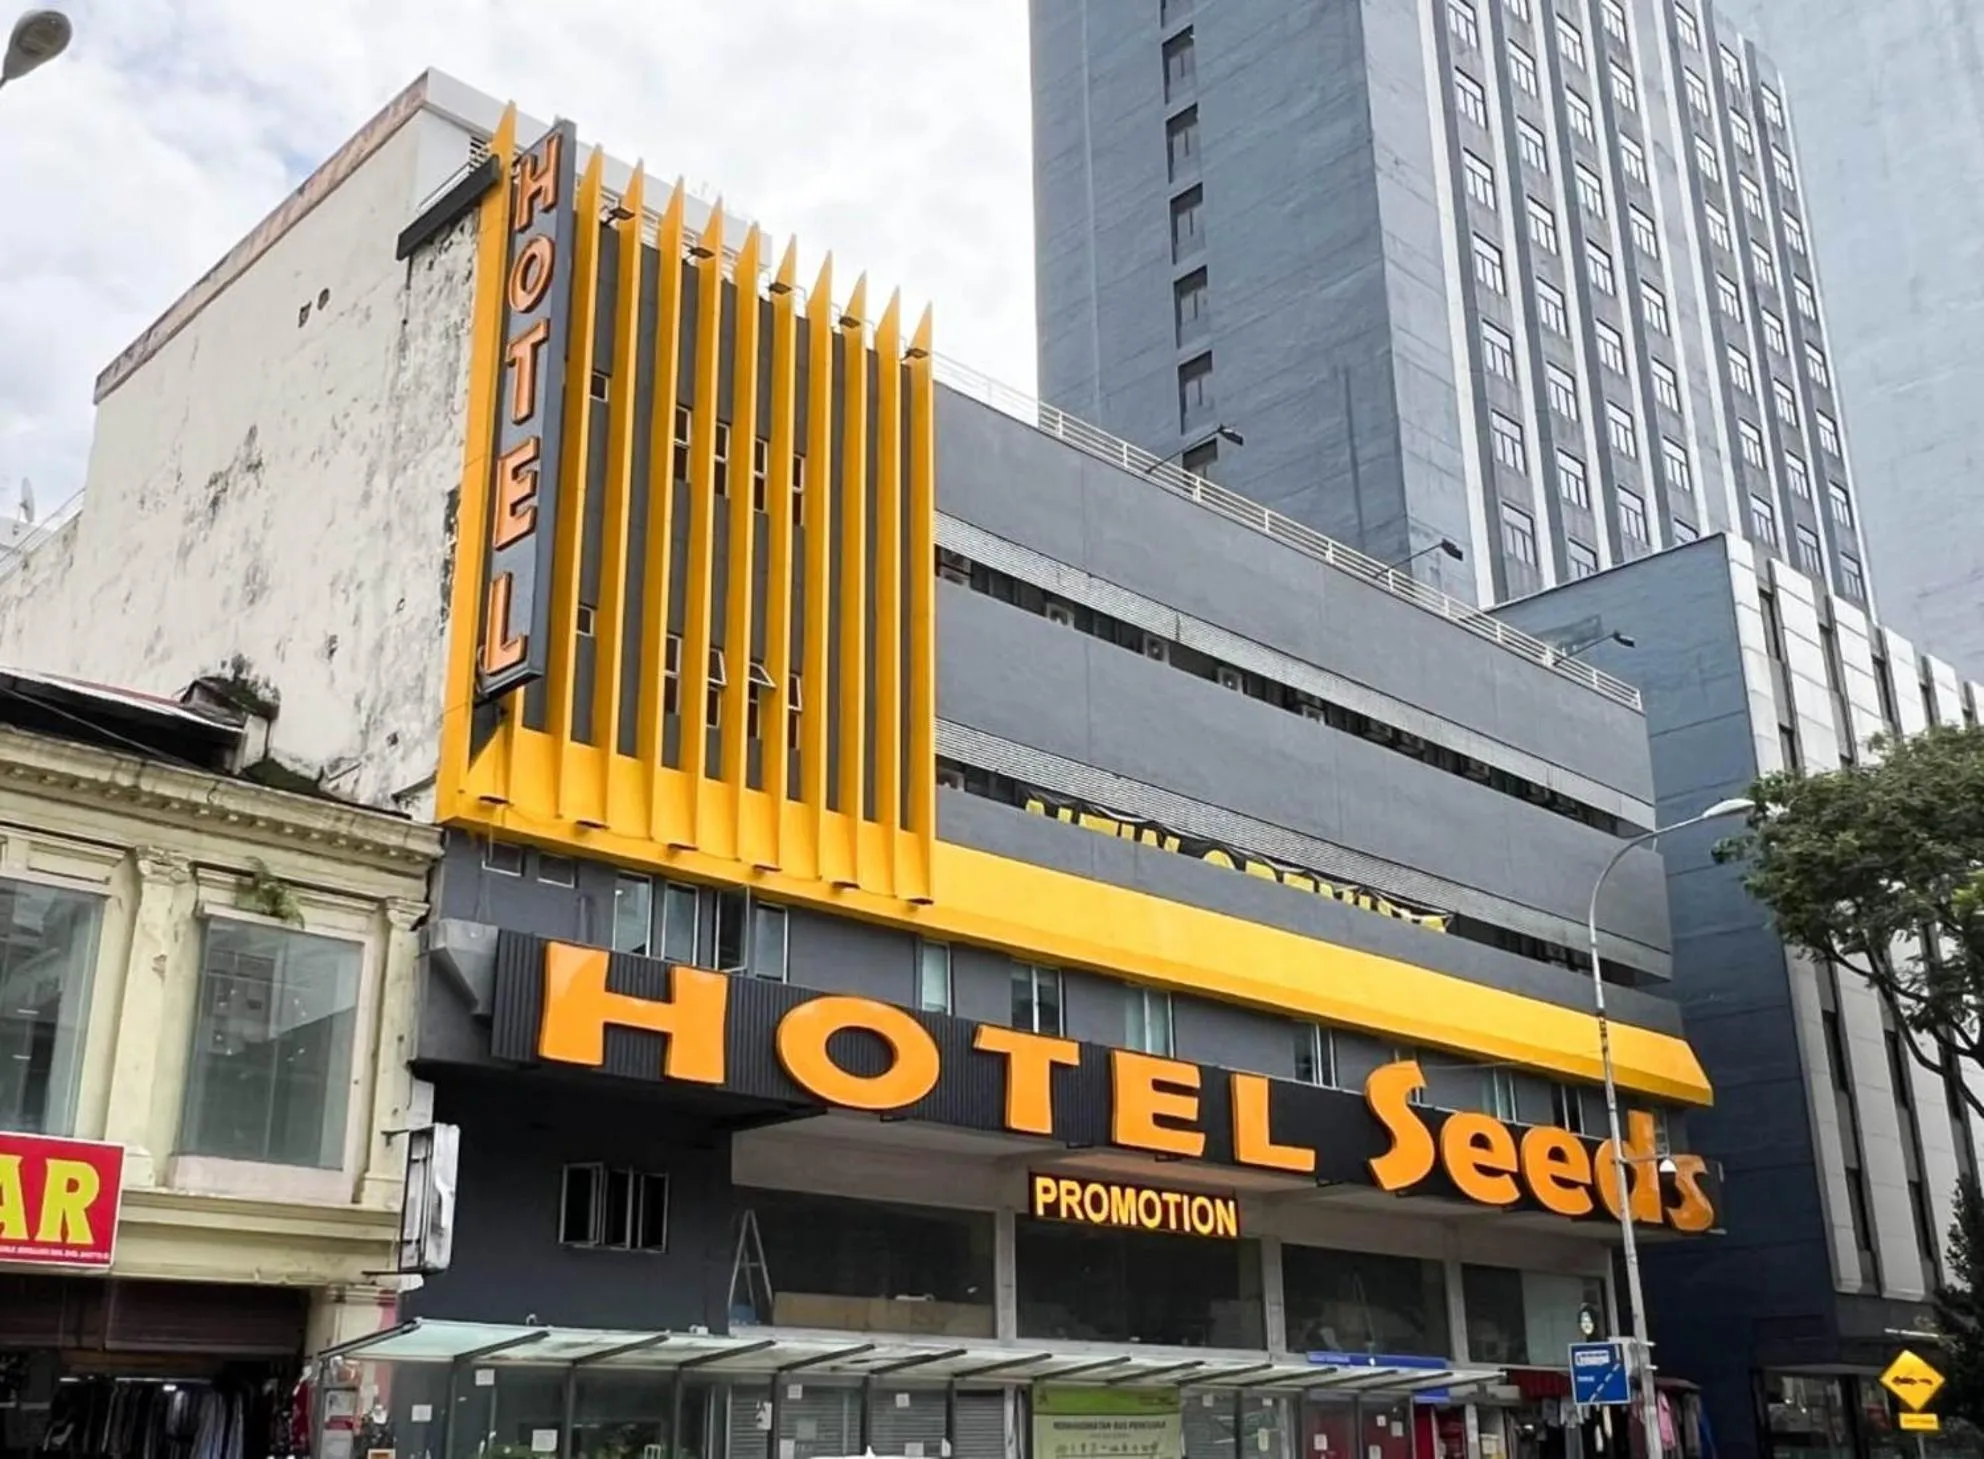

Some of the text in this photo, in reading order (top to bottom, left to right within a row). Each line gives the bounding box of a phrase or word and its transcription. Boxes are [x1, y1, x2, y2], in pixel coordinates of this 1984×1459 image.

[478, 132, 560, 675] HOTEL
[538, 940, 1714, 1232] HOTEL Seeds
[1034, 1175, 1238, 1237] PROMOTION
